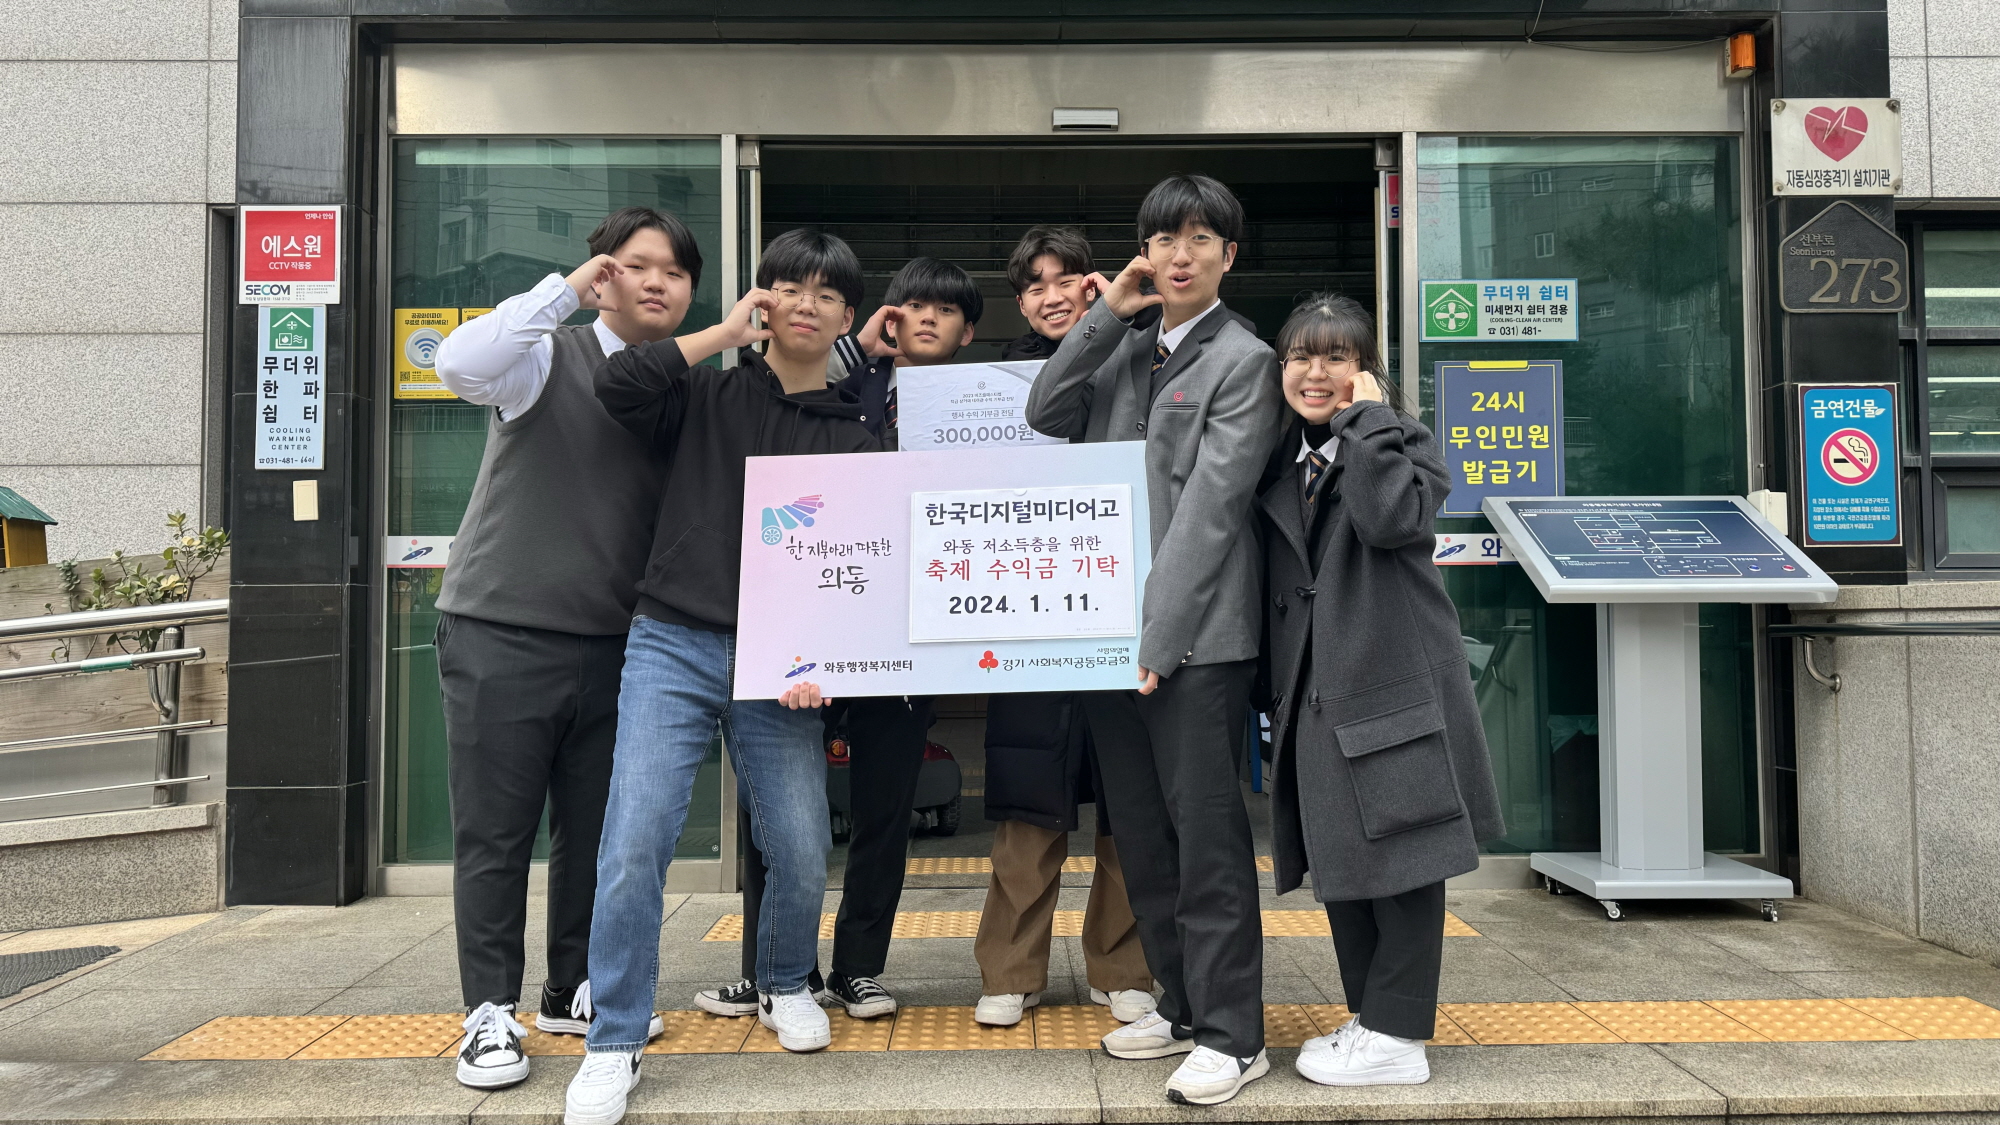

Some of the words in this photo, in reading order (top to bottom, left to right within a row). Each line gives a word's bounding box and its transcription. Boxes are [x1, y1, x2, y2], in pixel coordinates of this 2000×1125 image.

[1786, 169, 1850, 188] 자동심장충격기
[1853, 169, 1890, 188] 설치기관
[261, 235, 321, 258] 에스원
[1799, 233, 1835, 247] 선부로
[1790, 246, 1836, 257] Seonbu-ro
[269, 262, 290, 270] CCTV
[291, 262, 312, 270] 작동중
[245, 284, 291, 296] SECOM
[1808, 258, 1902, 304] 273
[1483, 285, 1530, 301] 무더위
[1539, 285, 1568, 301] 쉼터
[1485, 304, 1523, 315] 미세먼지
[1527, 304, 1546, 315] 쉼터
[1549, 304, 1569, 315] 겸용
[1499, 326, 1519, 337] 031)
[1522, 326, 1542, 336] 481-
[263, 356, 318, 375] 무더위
[1471, 391, 1525, 413] 24시
[1811, 399, 1878, 418] 금연건물
[951, 411, 964, 419] 행사
[966, 411, 979, 419] 수익
[980, 410, 999, 418] 기부금
[933, 423, 1034, 445] 300,000원
[1449, 425, 1550, 449] 무인민원
[1463, 460, 1537, 485] 발급기
[925, 498, 1120, 525] 한국디지털미디어고
[786, 535, 804, 561] 한
[807, 540, 853, 559] 지붕아래
[855, 538, 892, 557] 따뜻한
[942, 539, 975, 555] 와동
[983, 536, 1061, 554] 저소득층을
[1069, 535, 1102, 552] 위한
[925, 558, 970, 582] 축제
[987, 557, 1058, 581] 수익금
[1072, 555, 1120, 578] 기탁
[818, 565, 870, 595] 와동
[949, 595, 1016, 615] 2024.
[1030, 594, 1049, 613] 1.
[1063, 593, 1099, 612] 11.
[823, 658, 913, 674] 와동행정복지센터
[1002, 659, 1025, 671] 경기
[1028, 655, 1130, 669] 사회복지공동모금회
